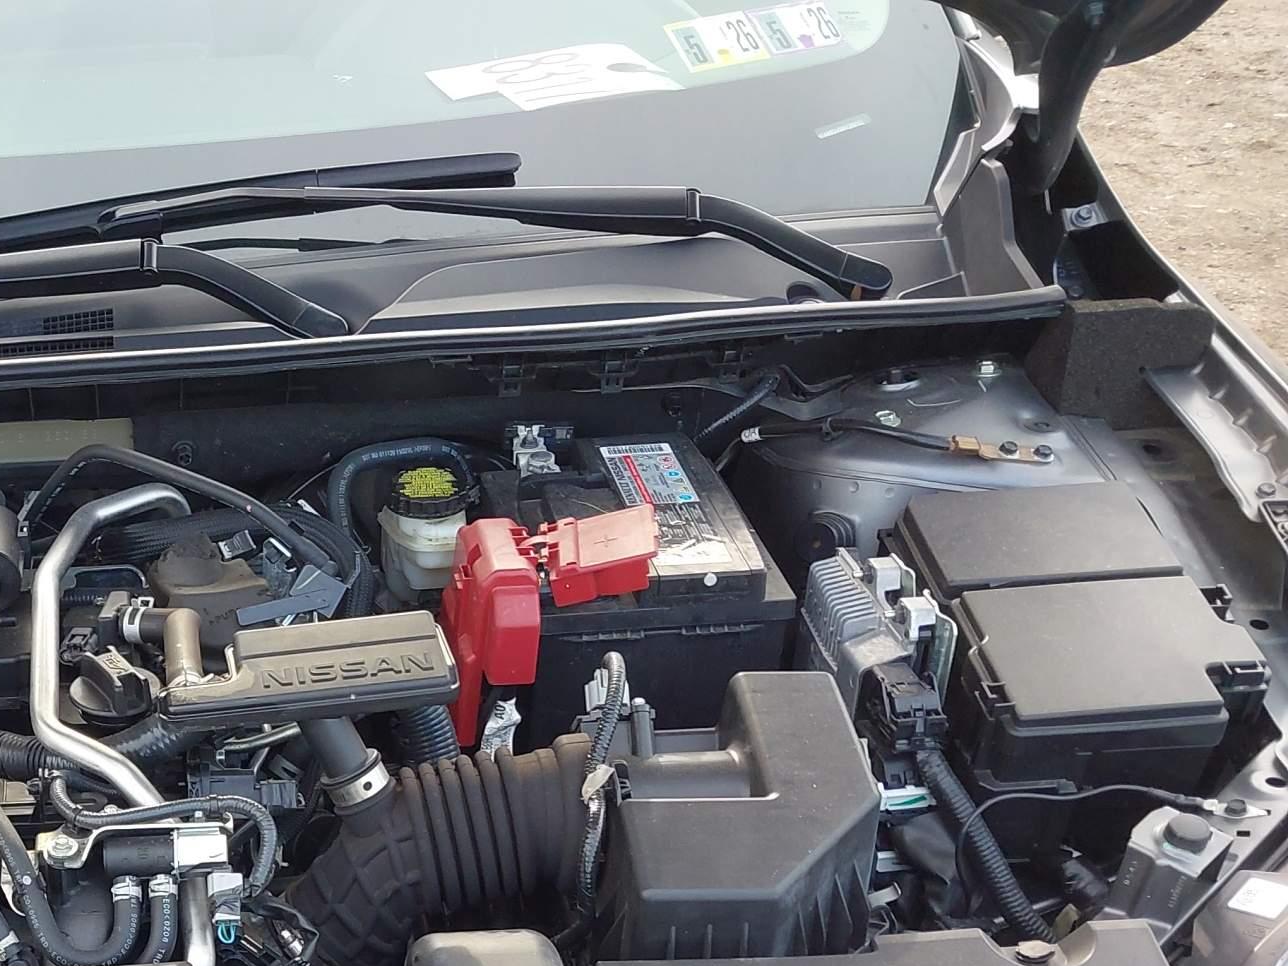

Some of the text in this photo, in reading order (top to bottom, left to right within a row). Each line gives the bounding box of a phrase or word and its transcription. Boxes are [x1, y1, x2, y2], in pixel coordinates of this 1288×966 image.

[726, 18, 761, 53] 26
[807, 6, 841, 40] 26
[261, 652, 435, 690] NISSAN
